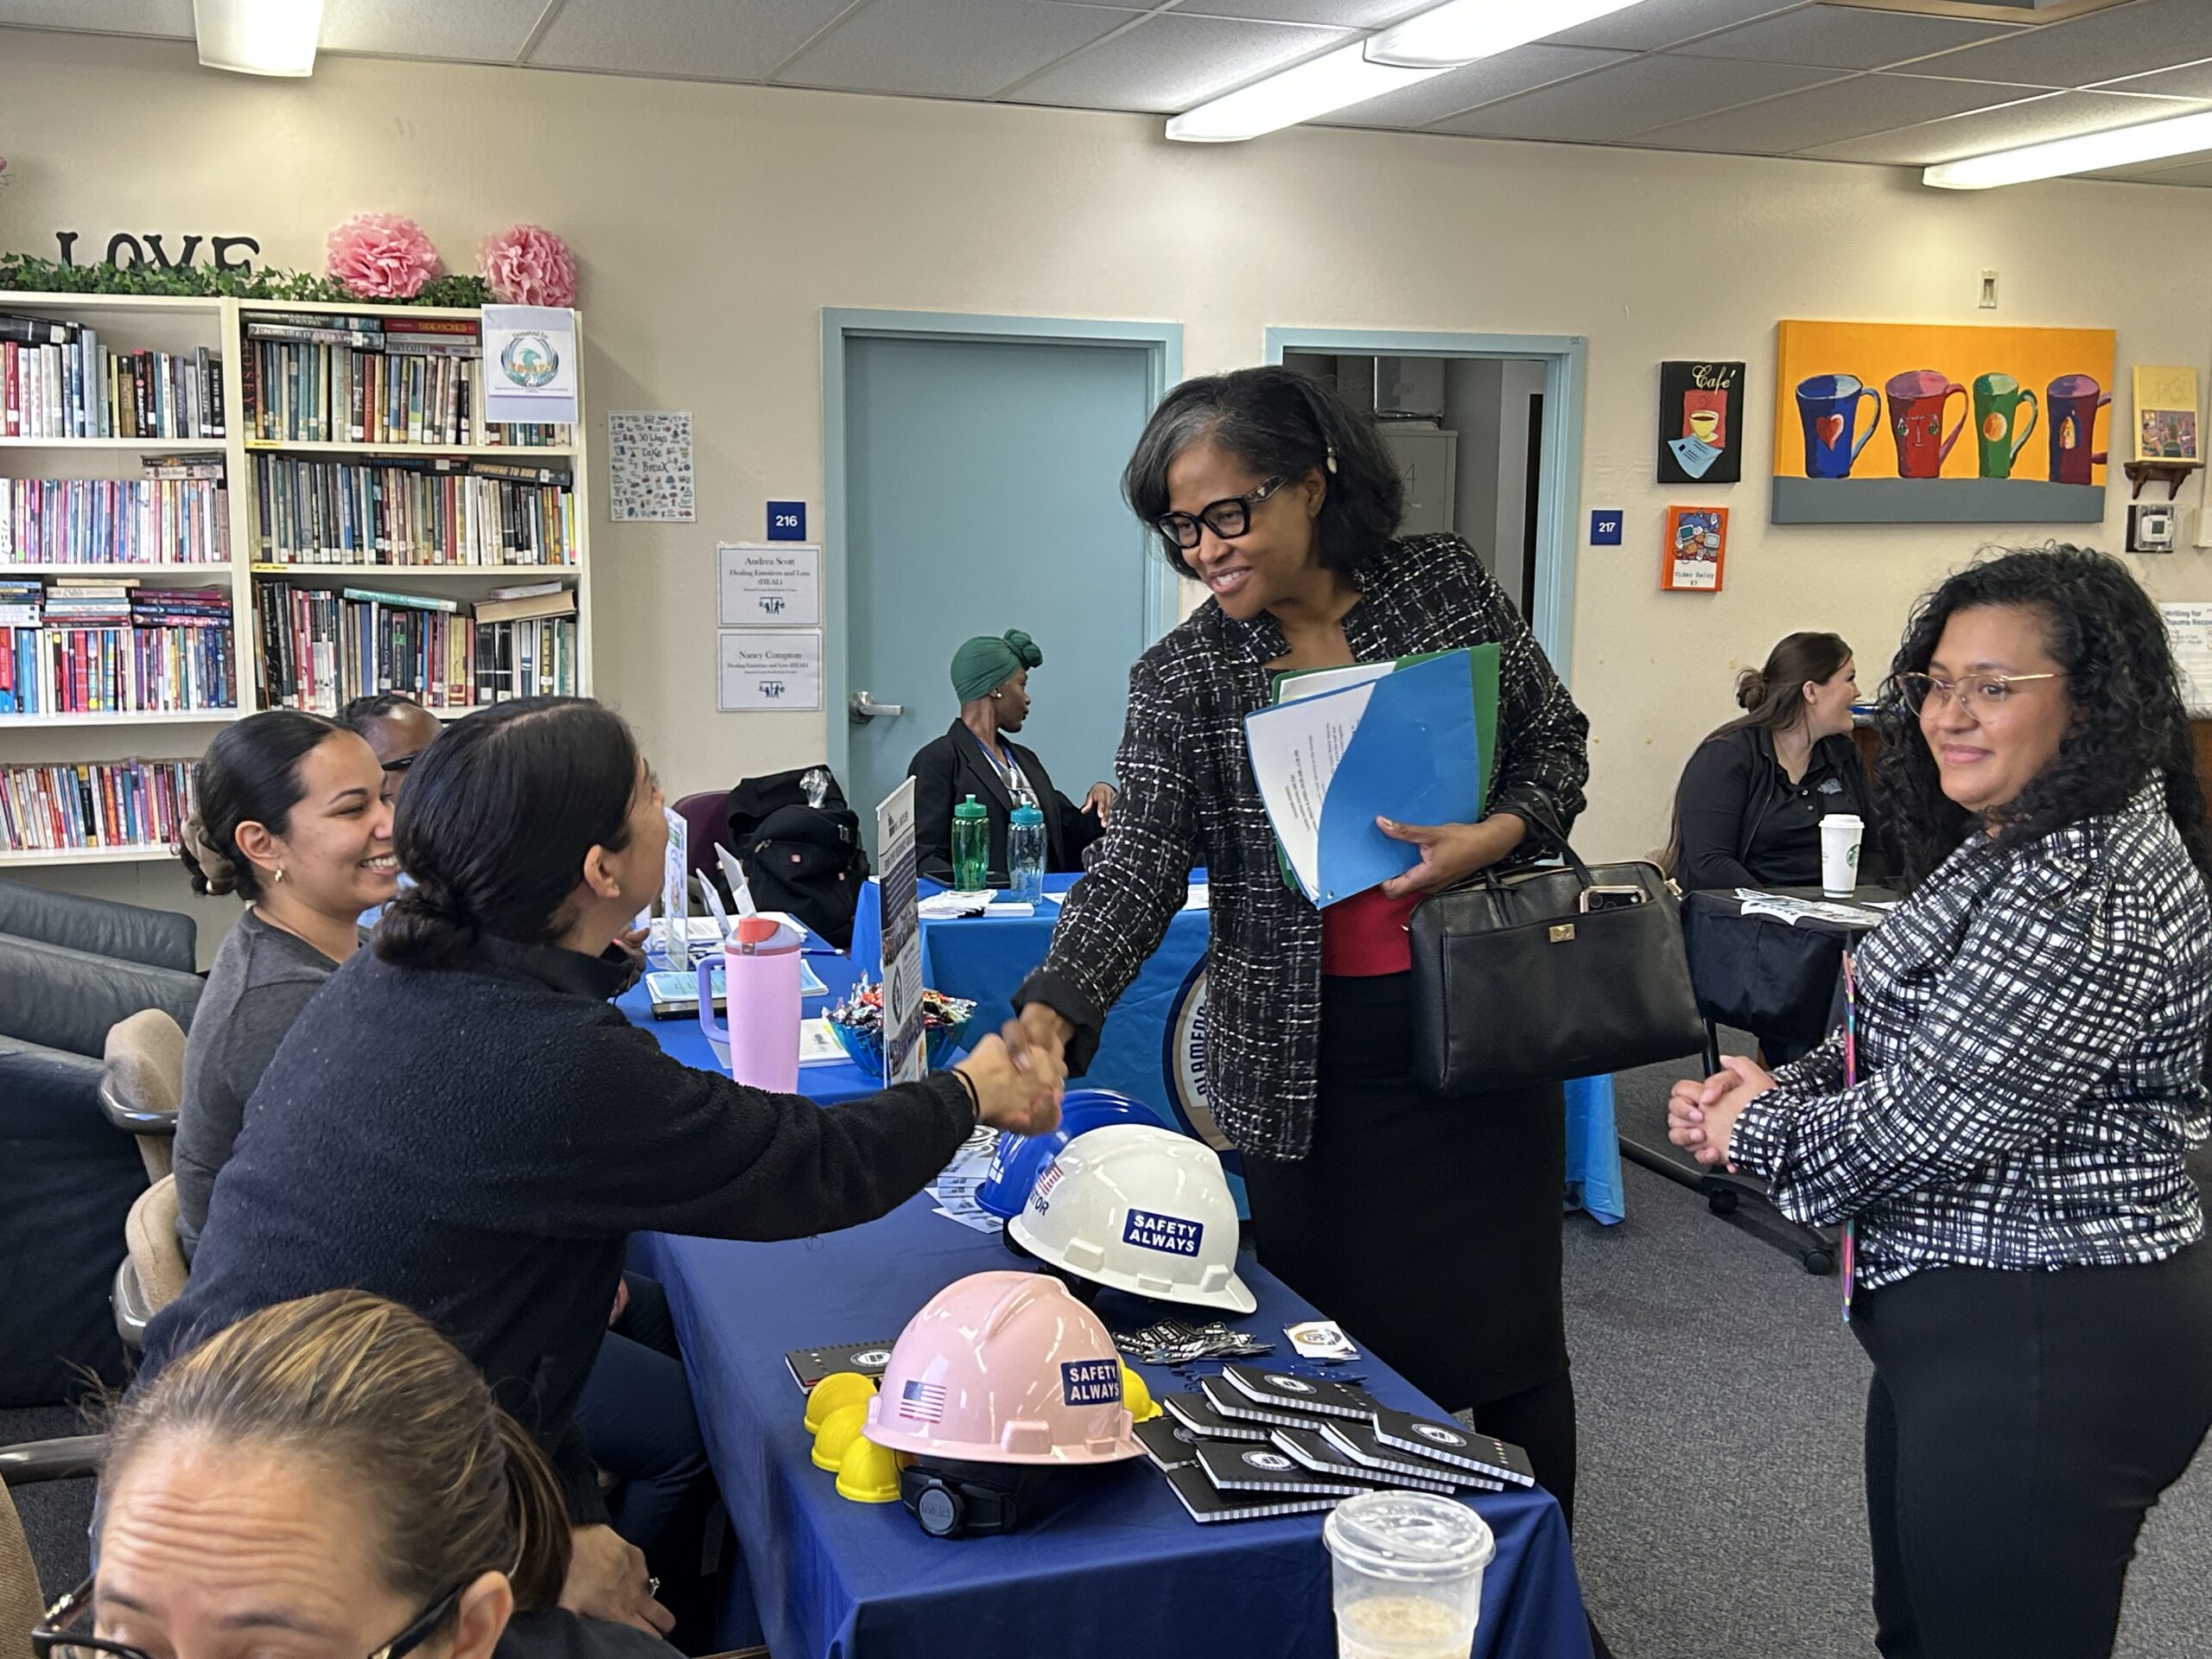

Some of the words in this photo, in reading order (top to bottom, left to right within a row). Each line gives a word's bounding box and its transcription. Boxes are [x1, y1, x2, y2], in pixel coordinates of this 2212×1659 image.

[512, 330, 540, 340] Donated
[1692, 365, 1736, 395] Café
[136, 387, 145, 429] SEABISCUIT
[776, 515, 798, 526] 216
[1599, 523, 1616, 532] 217
[740, 651, 763, 660] Nancy
[765, 651, 803, 660] Compton
[1134, 1215, 1197, 1237] SAFETY
[1128, 1229, 1195, 1252] ALWAYS
[1069, 1365, 1116, 1382] SAFETY
[1070, 1383, 1120, 1401] ALWAYS
